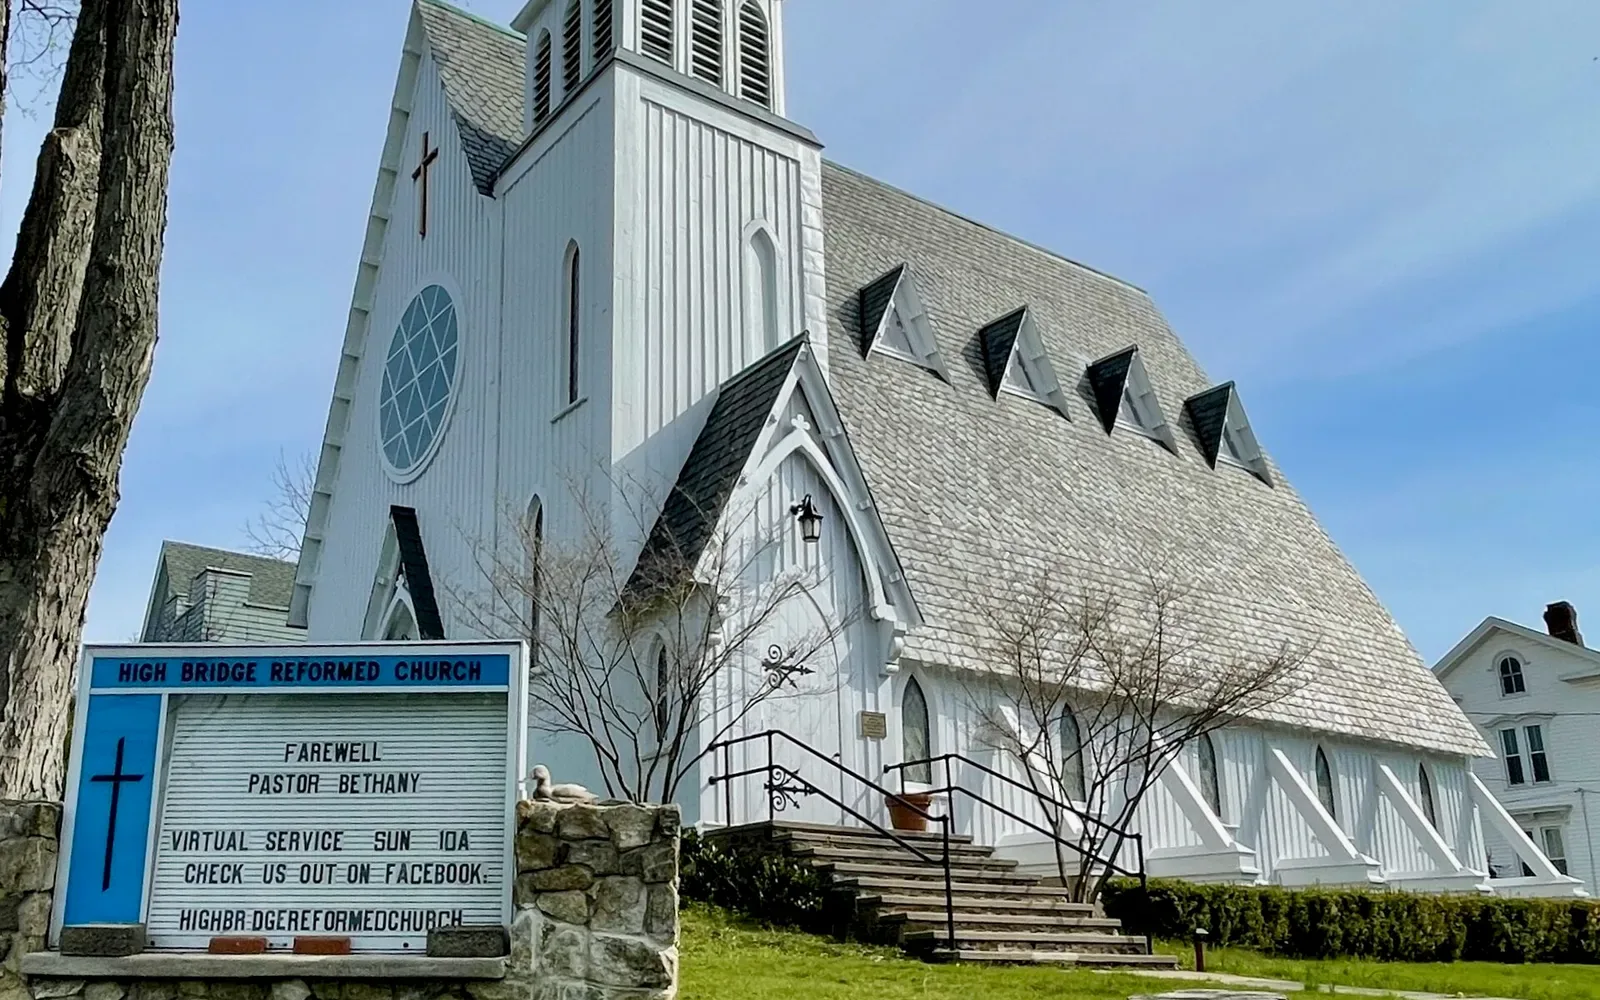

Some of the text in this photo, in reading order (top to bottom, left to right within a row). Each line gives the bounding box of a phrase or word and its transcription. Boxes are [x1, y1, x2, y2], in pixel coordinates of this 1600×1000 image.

[119, 660, 481, 682] HIGH BRIDGE REFORMED CHURCH
[284, 742, 382, 762] FAREWELL
[248, 772, 420, 794] PASTOR BETHANY
[172, 830, 470, 851] VIRTUAL SERVICE SUN 10A
[184, 864, 244, 884] CHECK
[262, 864, 287, 884] US
[300, 864, 337, 884] OUT
[347, 864, 370, 884] ON
